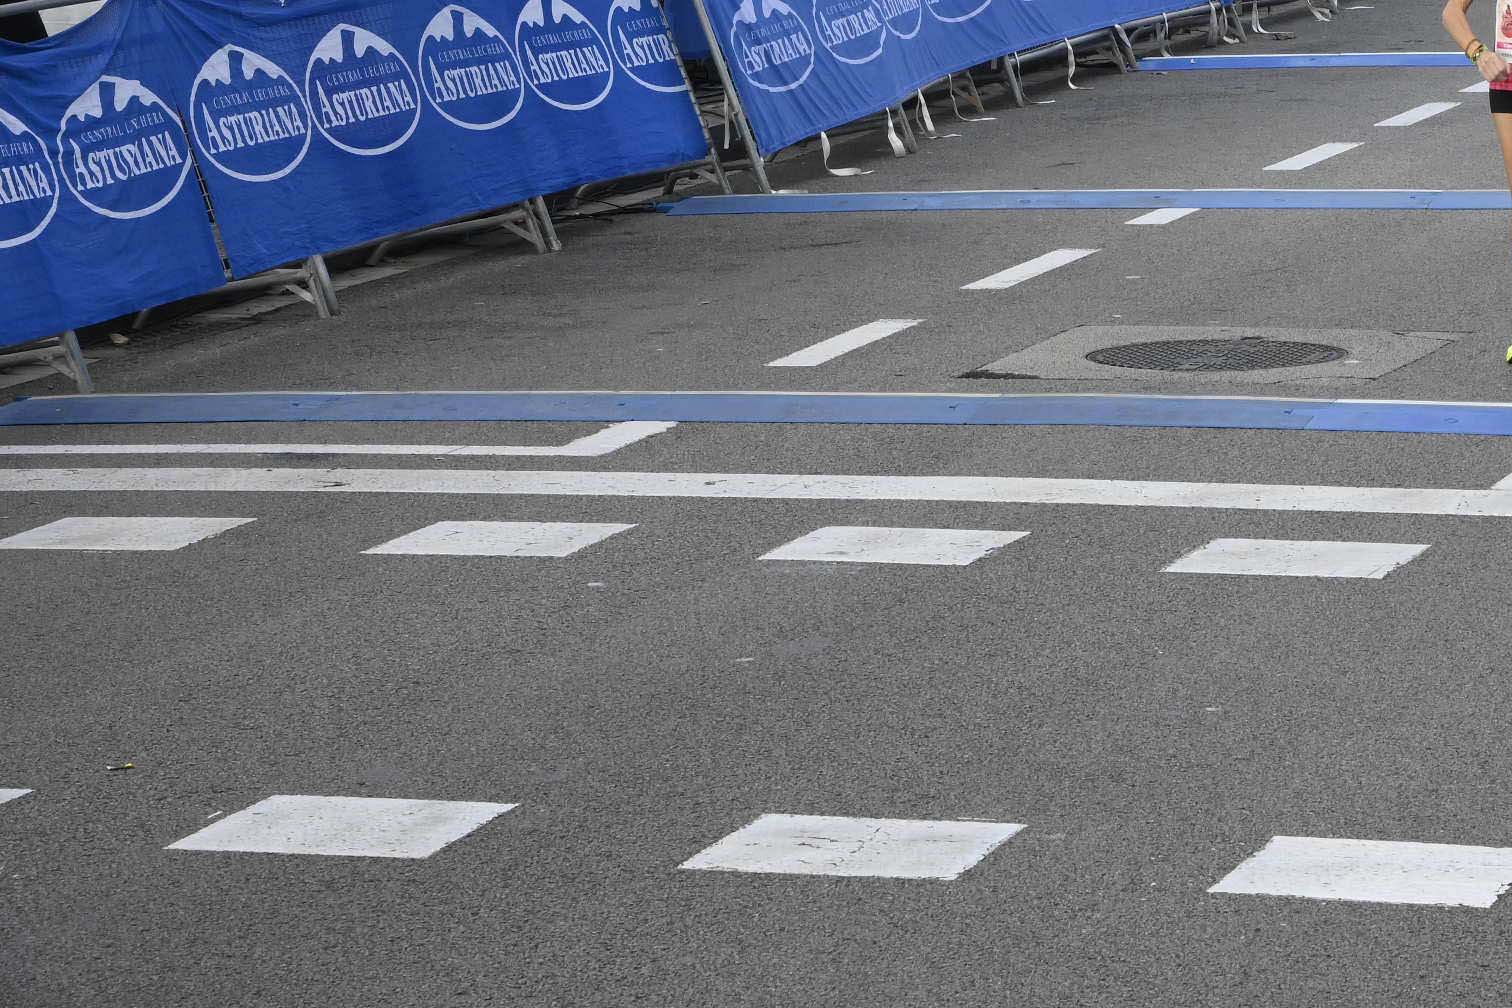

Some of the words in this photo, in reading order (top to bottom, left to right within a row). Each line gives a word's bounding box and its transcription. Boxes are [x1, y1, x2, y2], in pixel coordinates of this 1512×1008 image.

[429, 55, 520, 103] ASTURIANA
[524, 40, 609, 85] ASTURIANA
[202, 102, 306, 155] ASTURIANA
[316, 79, 416, 129] ASTURIANA
[70, 130, 184, 191] ASTURIANA
